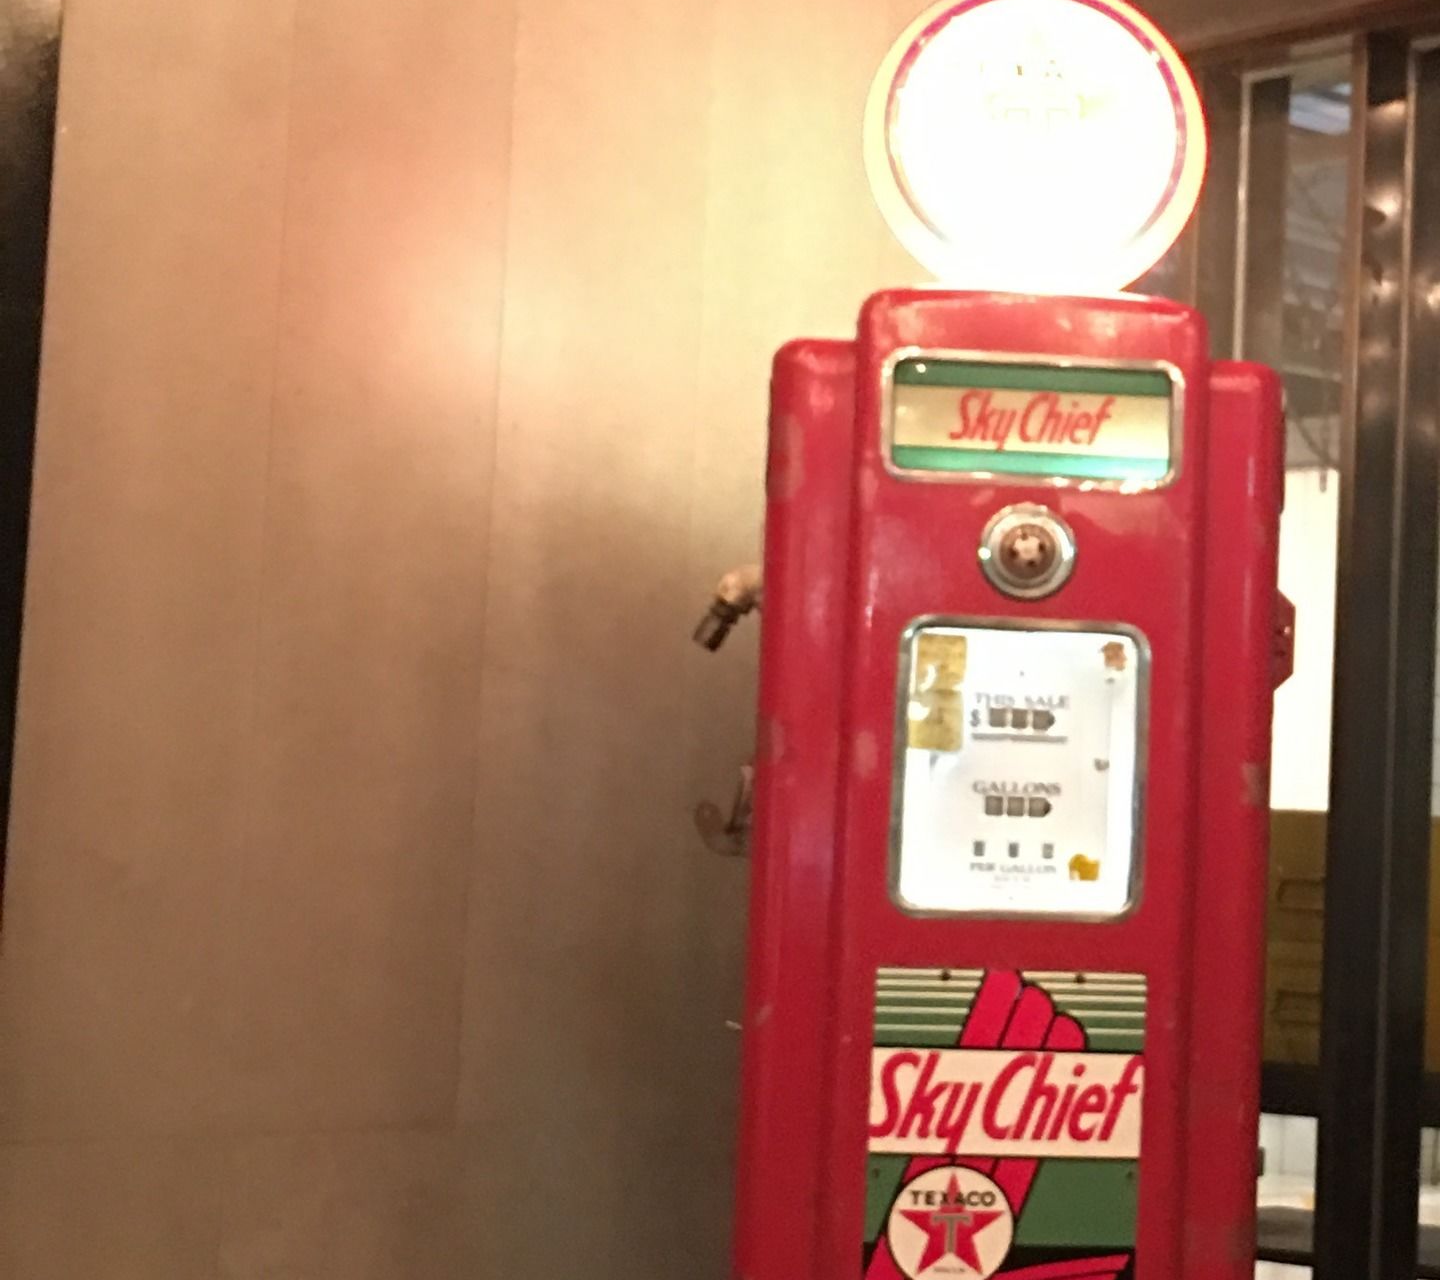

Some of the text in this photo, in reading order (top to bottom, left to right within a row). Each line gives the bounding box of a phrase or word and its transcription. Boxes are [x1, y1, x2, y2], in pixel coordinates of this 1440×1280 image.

[949, 388, 1116, 452] Sky Chief
[972, 781, 1062, 795] GALLONS
[868, 1051, 1145, 1156] Sky Chief
[910, 1189, 997, 1207] TEXACO
